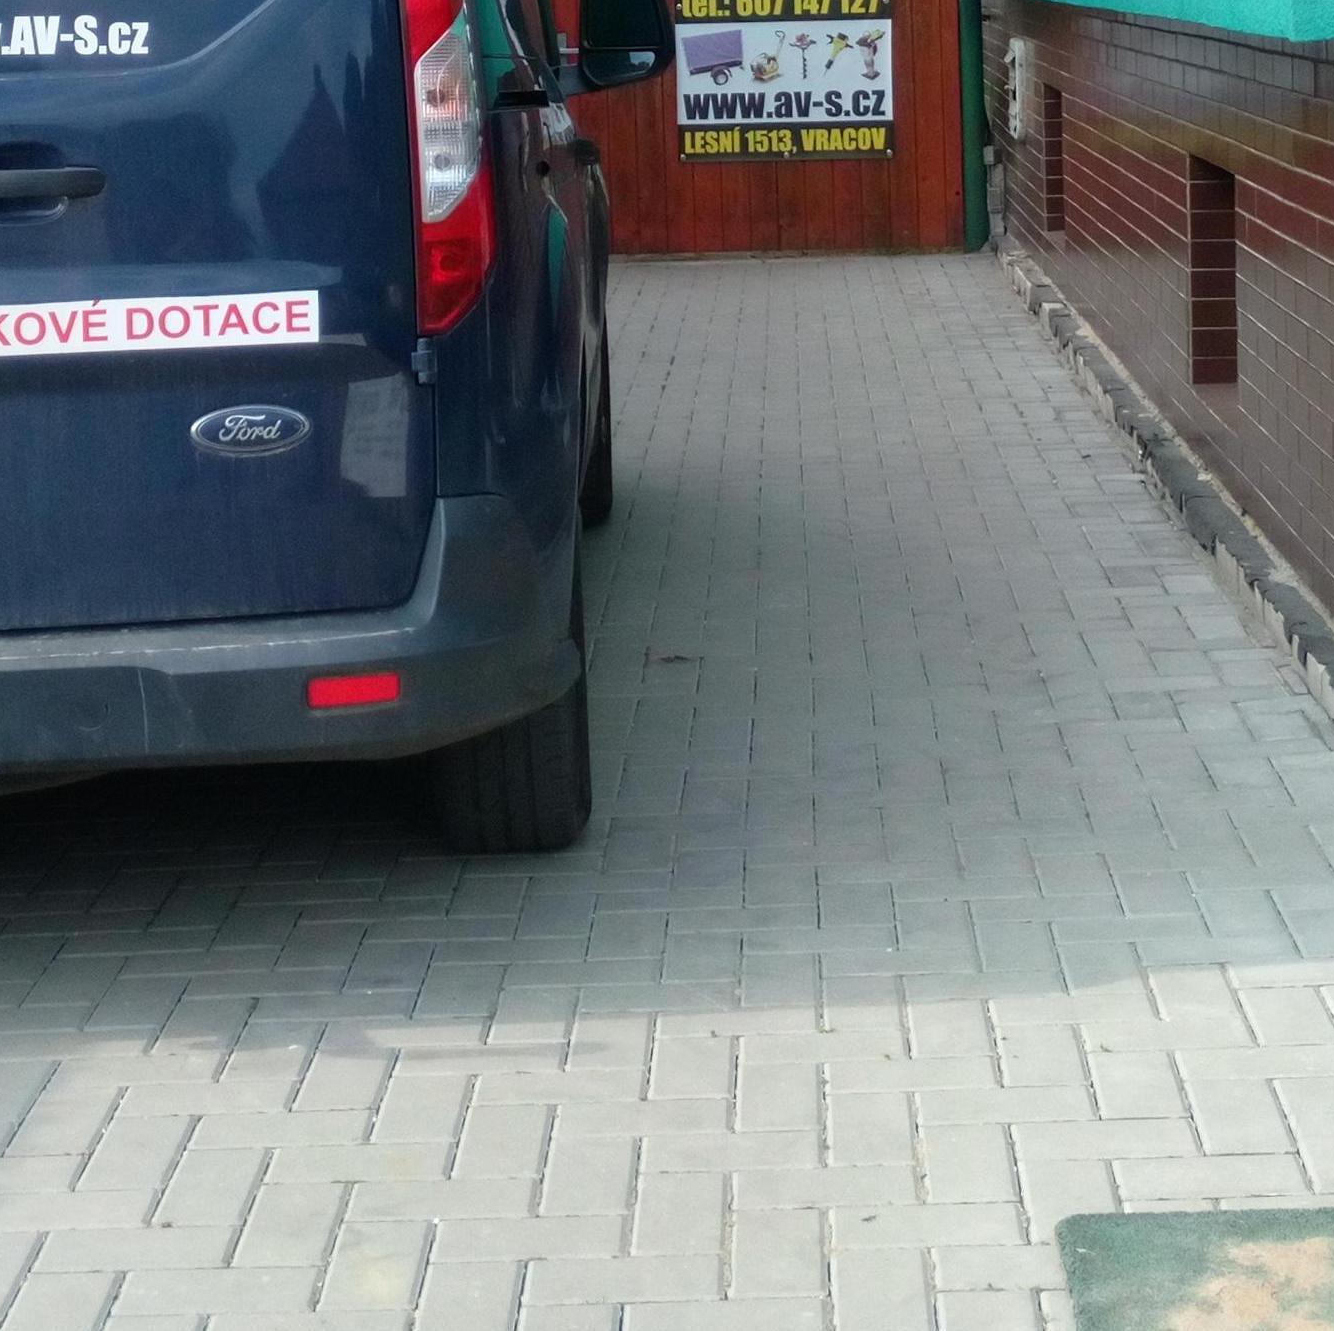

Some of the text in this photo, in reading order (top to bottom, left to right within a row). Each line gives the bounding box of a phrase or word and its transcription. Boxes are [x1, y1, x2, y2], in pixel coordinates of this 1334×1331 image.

[683, 89, 886, 121] www.av-s.cz
[684, 126, 886, 154] LESNÍ 1513, VRACOV
[125, 299, 311, 341] DOTACE
[218, 414, 281, 444] Ford
